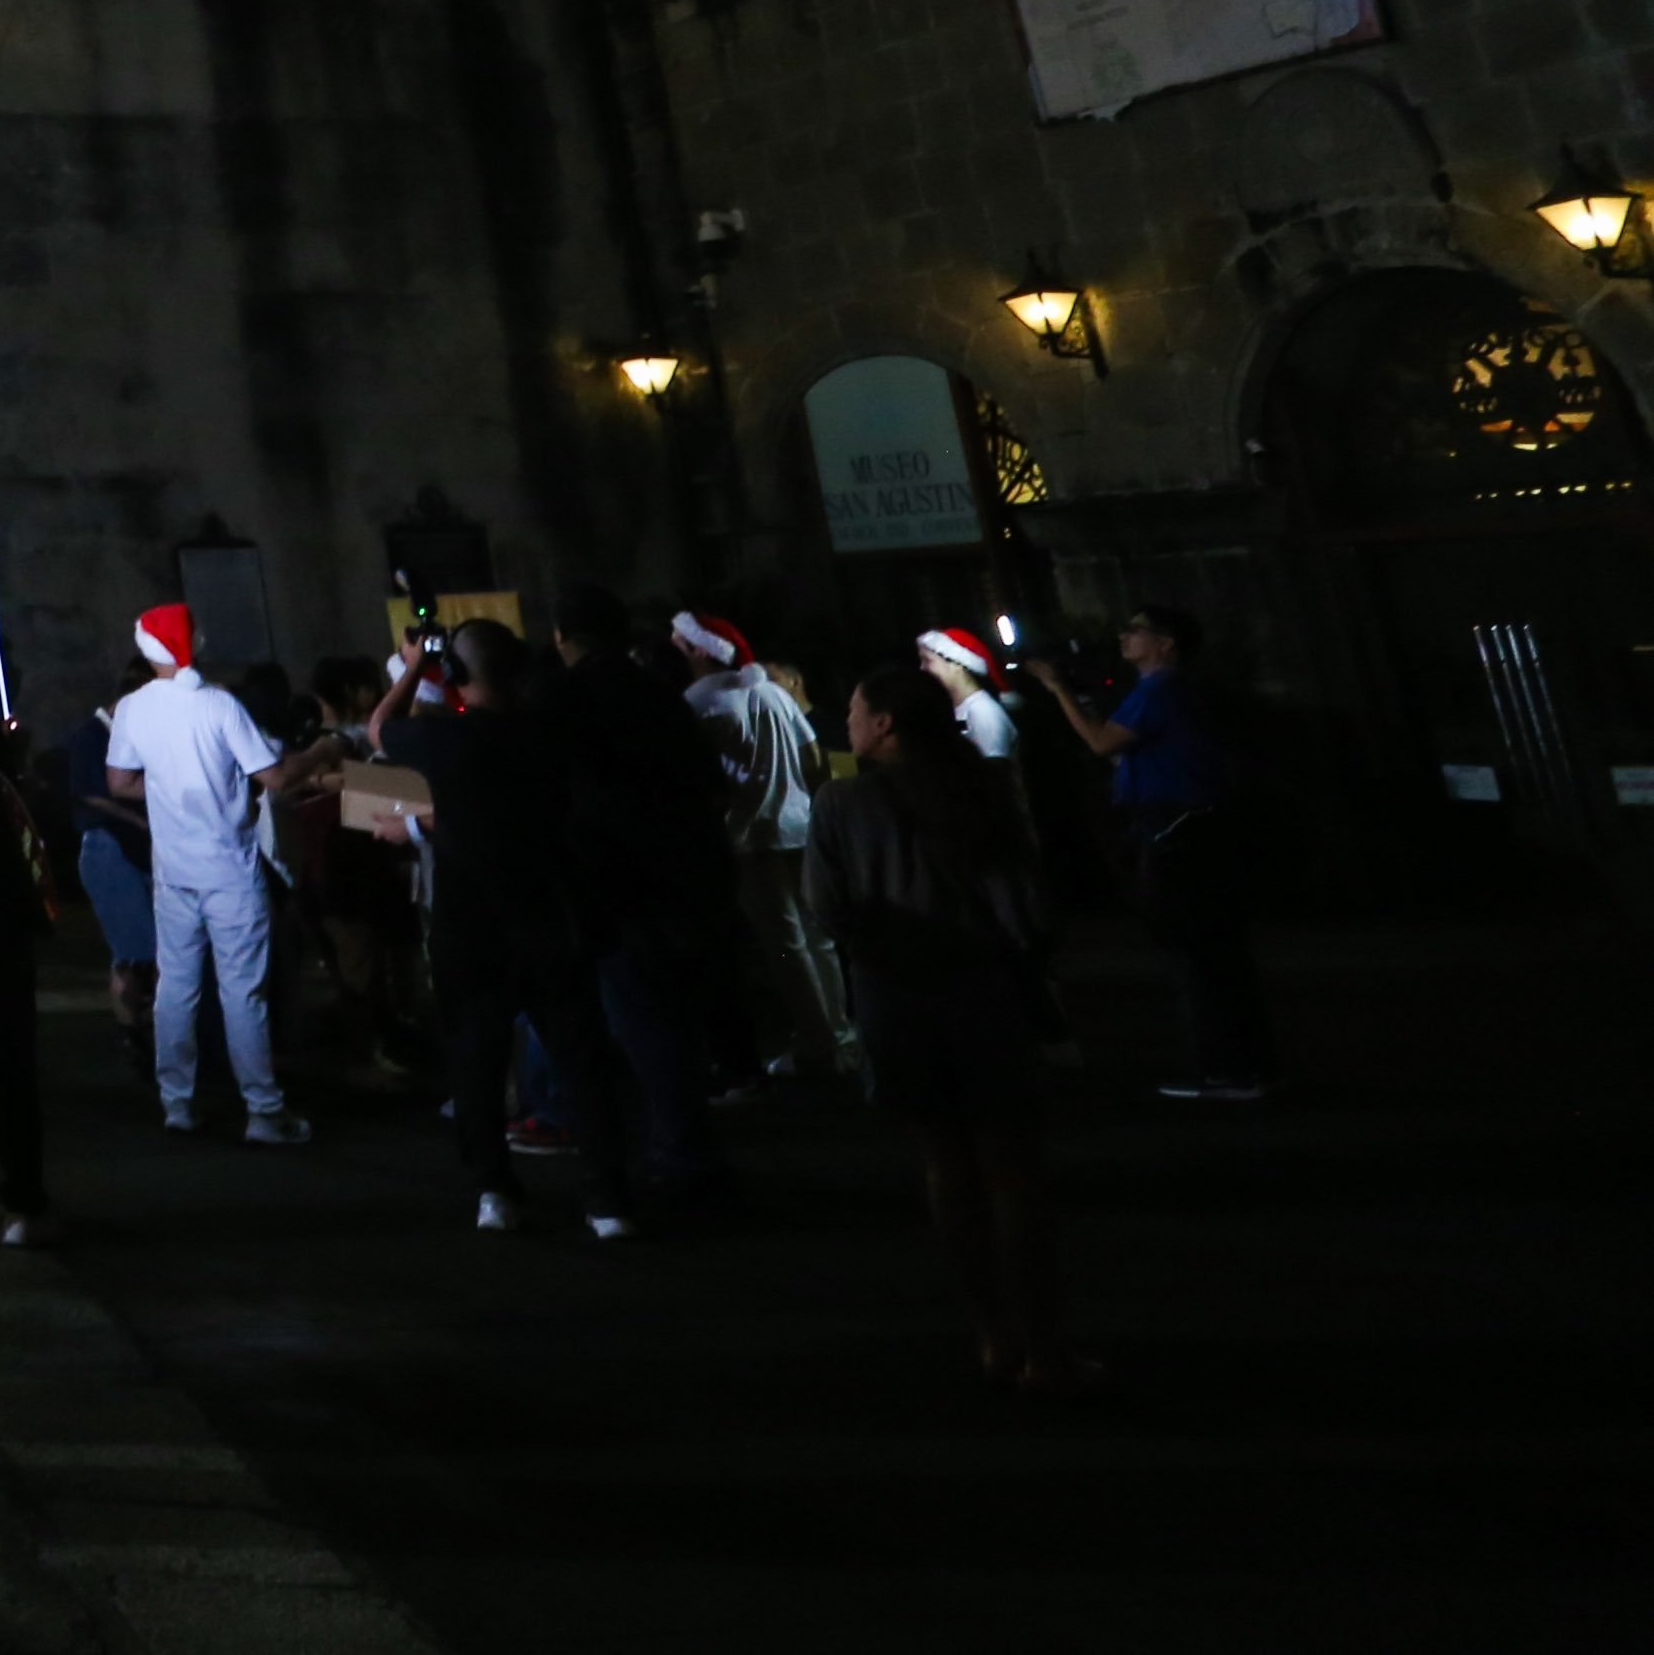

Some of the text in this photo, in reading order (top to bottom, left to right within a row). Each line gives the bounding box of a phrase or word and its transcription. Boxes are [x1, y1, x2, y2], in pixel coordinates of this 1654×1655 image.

[850, 449, 931, 484] MUSEO
[824, 482, 976, 519] SAN AGUSTIN
